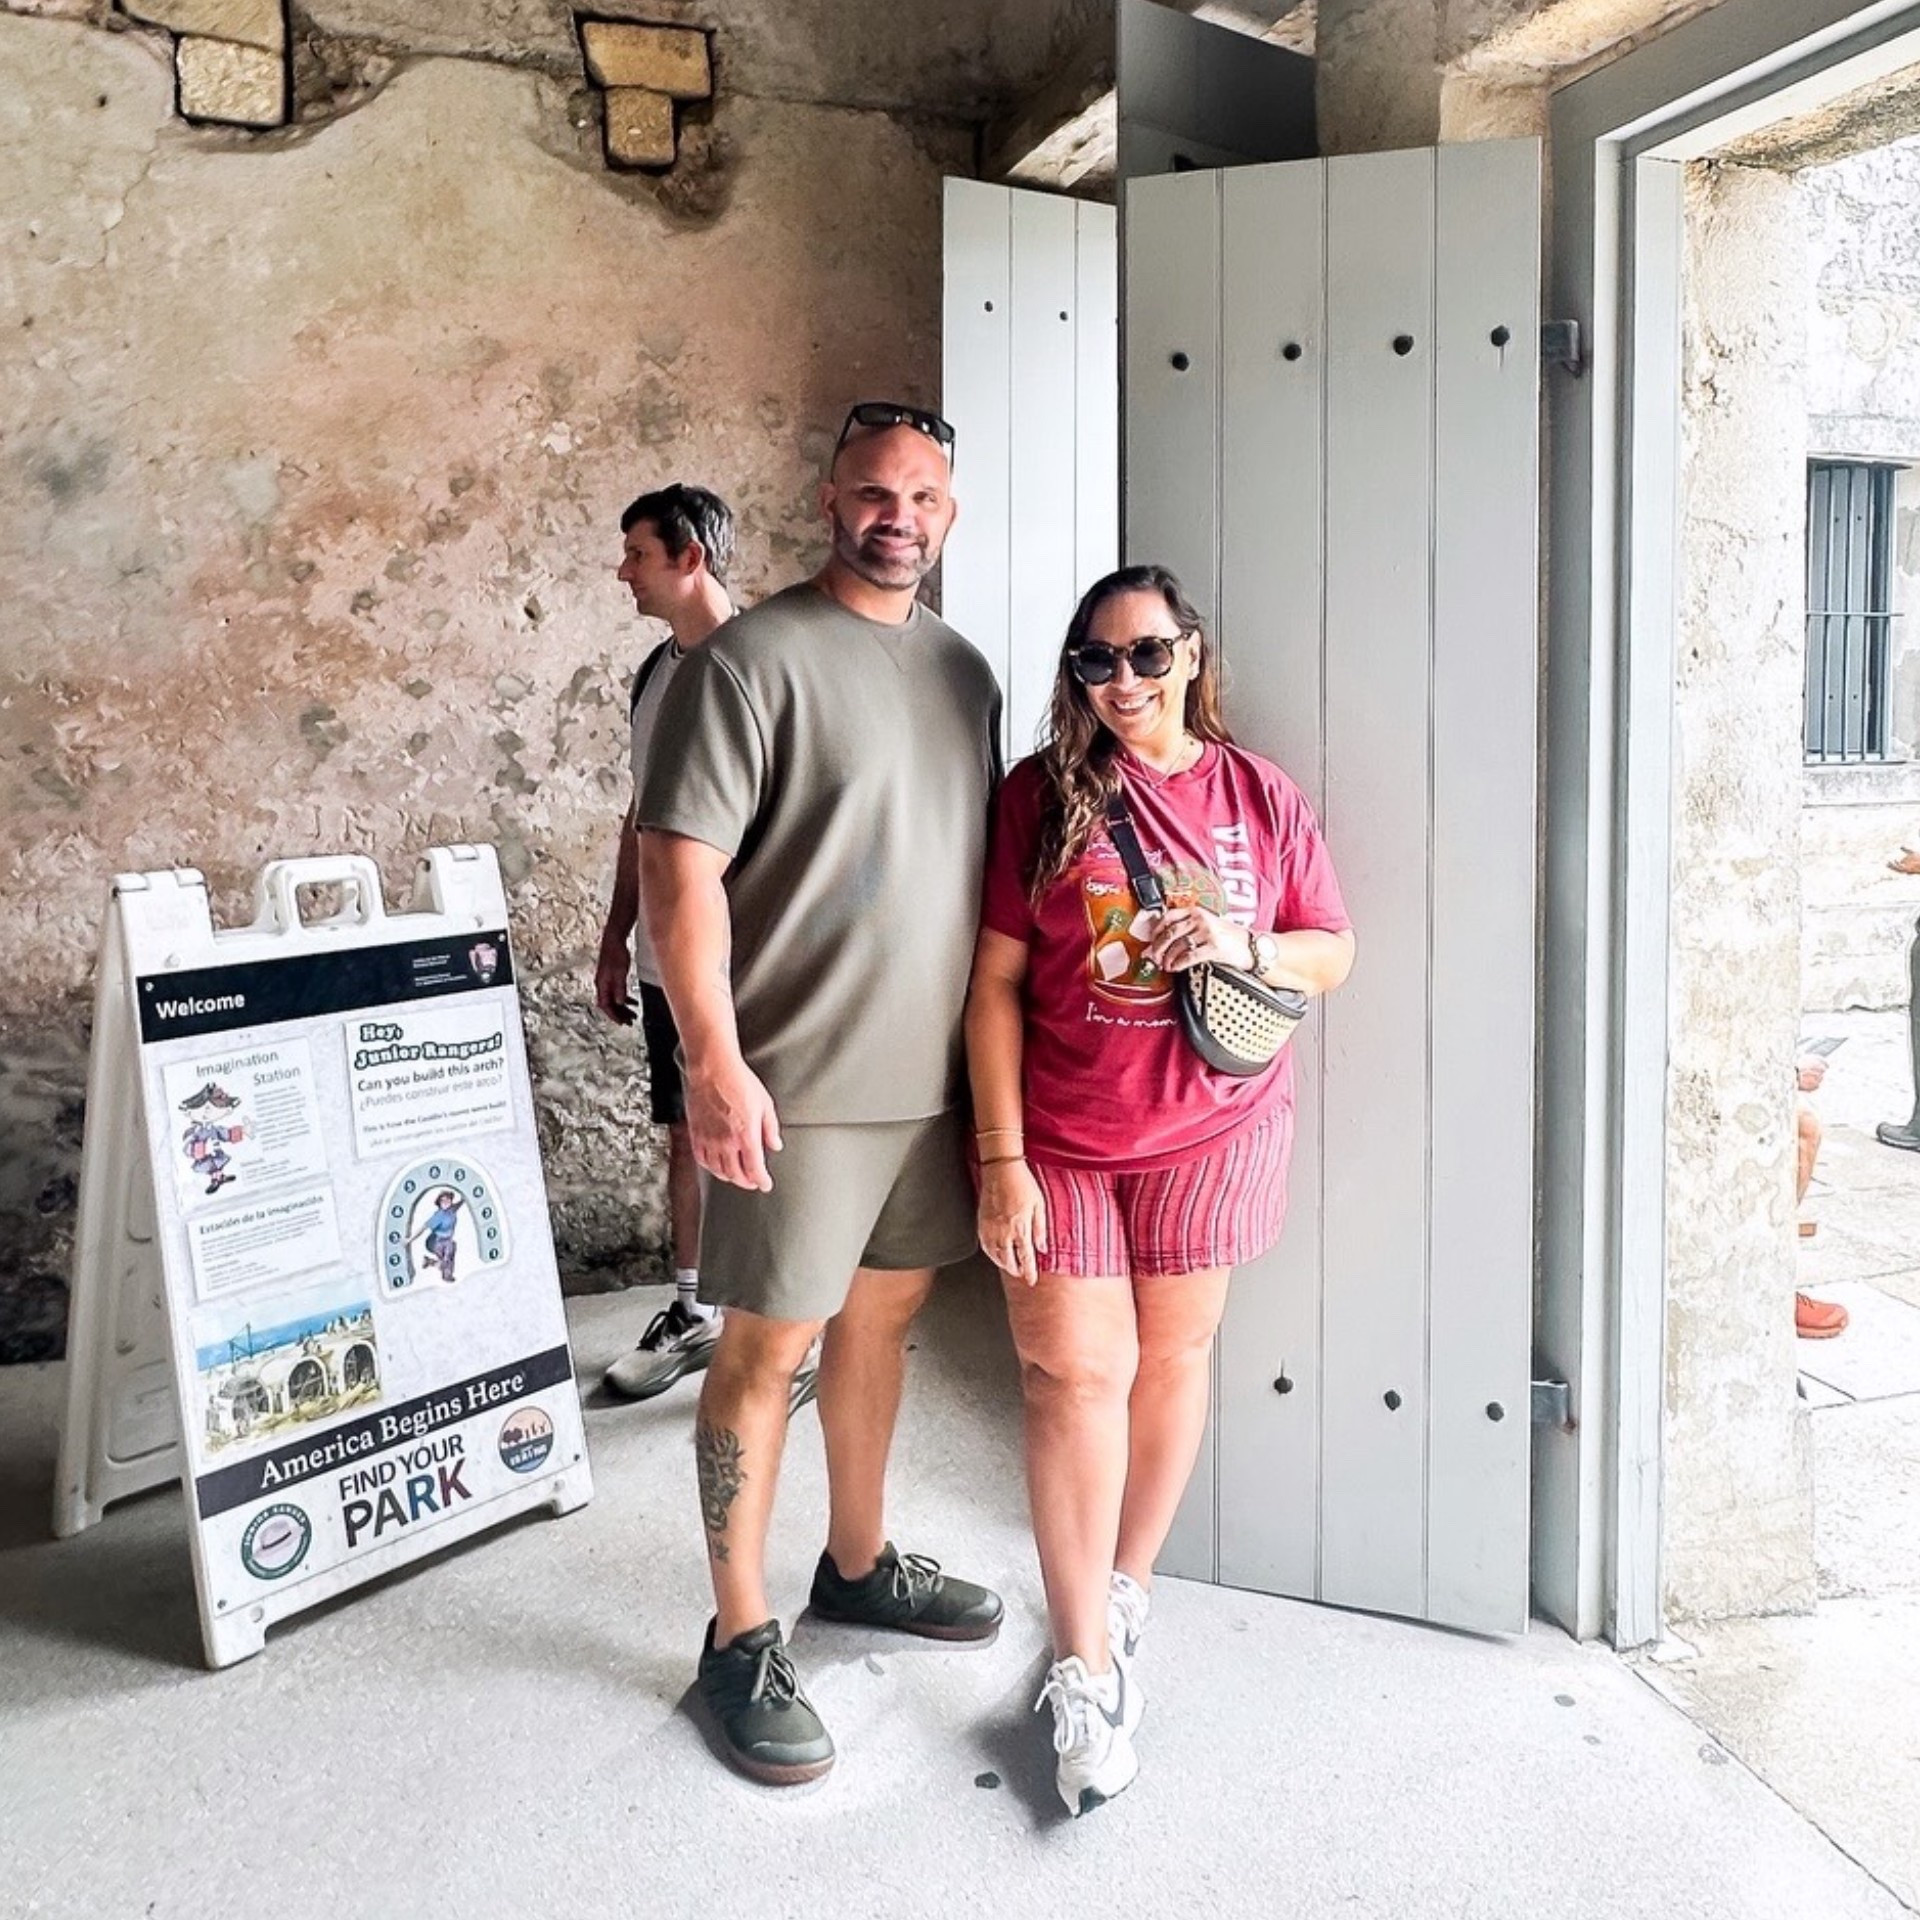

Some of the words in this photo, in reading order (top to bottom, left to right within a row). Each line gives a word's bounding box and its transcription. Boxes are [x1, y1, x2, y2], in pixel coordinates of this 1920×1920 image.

[1211, 822, 1257, 928] ACITA
[155, 994, 245, 1019] Welcome
[360, 1023, 403, 1042] Hey,
[197, 1051, 279, 1078] Imagination
[355, 1043, 420, 1070] Junior
[421, 1031, 502, 1060] Rangers!
[253, 1066, 301, 1087] Station
[358, 1078, 382, 1092] Can
[385, 1075, 410, 1090] you
[413, 1066, 445, 1083] build
[448, 1062, 470, 1077] this
[473, 1057, 504, 1073] arch?
[200, 1216, 240, 1236] Estación
[242, 1212, 254, 1225] de
[256, 1210, 265, 1220] la
[261, 1429, 375, 1489] America
[379, 1396, 463, 1436] Begins
[466, 1374, 524, 1410] Here
[339, 1461, 396, 1500] FIND
[398, 1434, 465, 1475] YOUR
[342, 1457, 472, 1548] PARK
